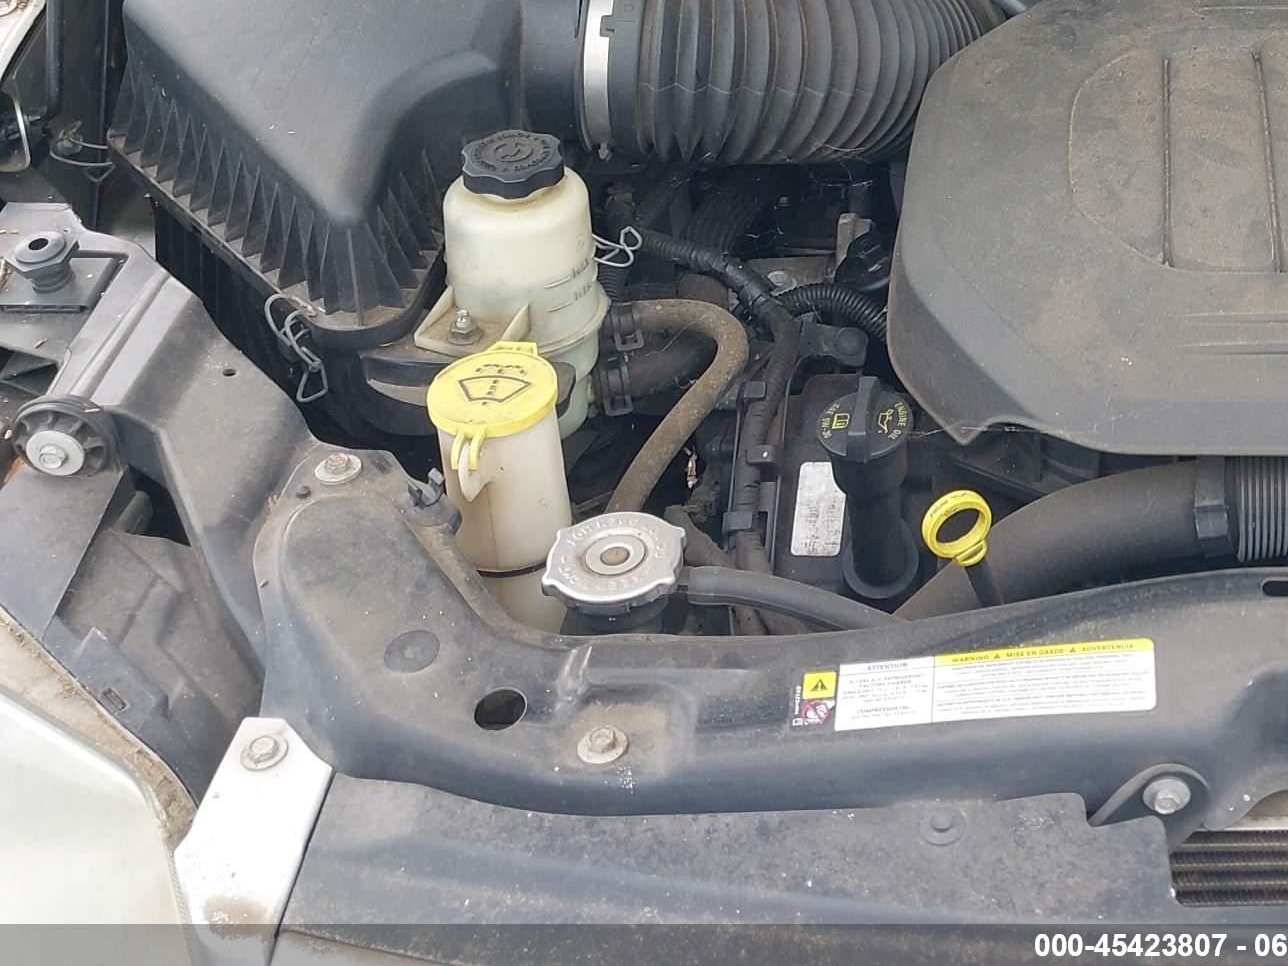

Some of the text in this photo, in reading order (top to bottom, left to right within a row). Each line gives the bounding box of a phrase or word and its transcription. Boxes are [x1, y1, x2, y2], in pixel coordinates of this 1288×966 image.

[888, 402, 908, 440] ENGINE OIL
[952, 655, 989, 663] WARNING
[867, 662, 908, 671] ATTENTION
